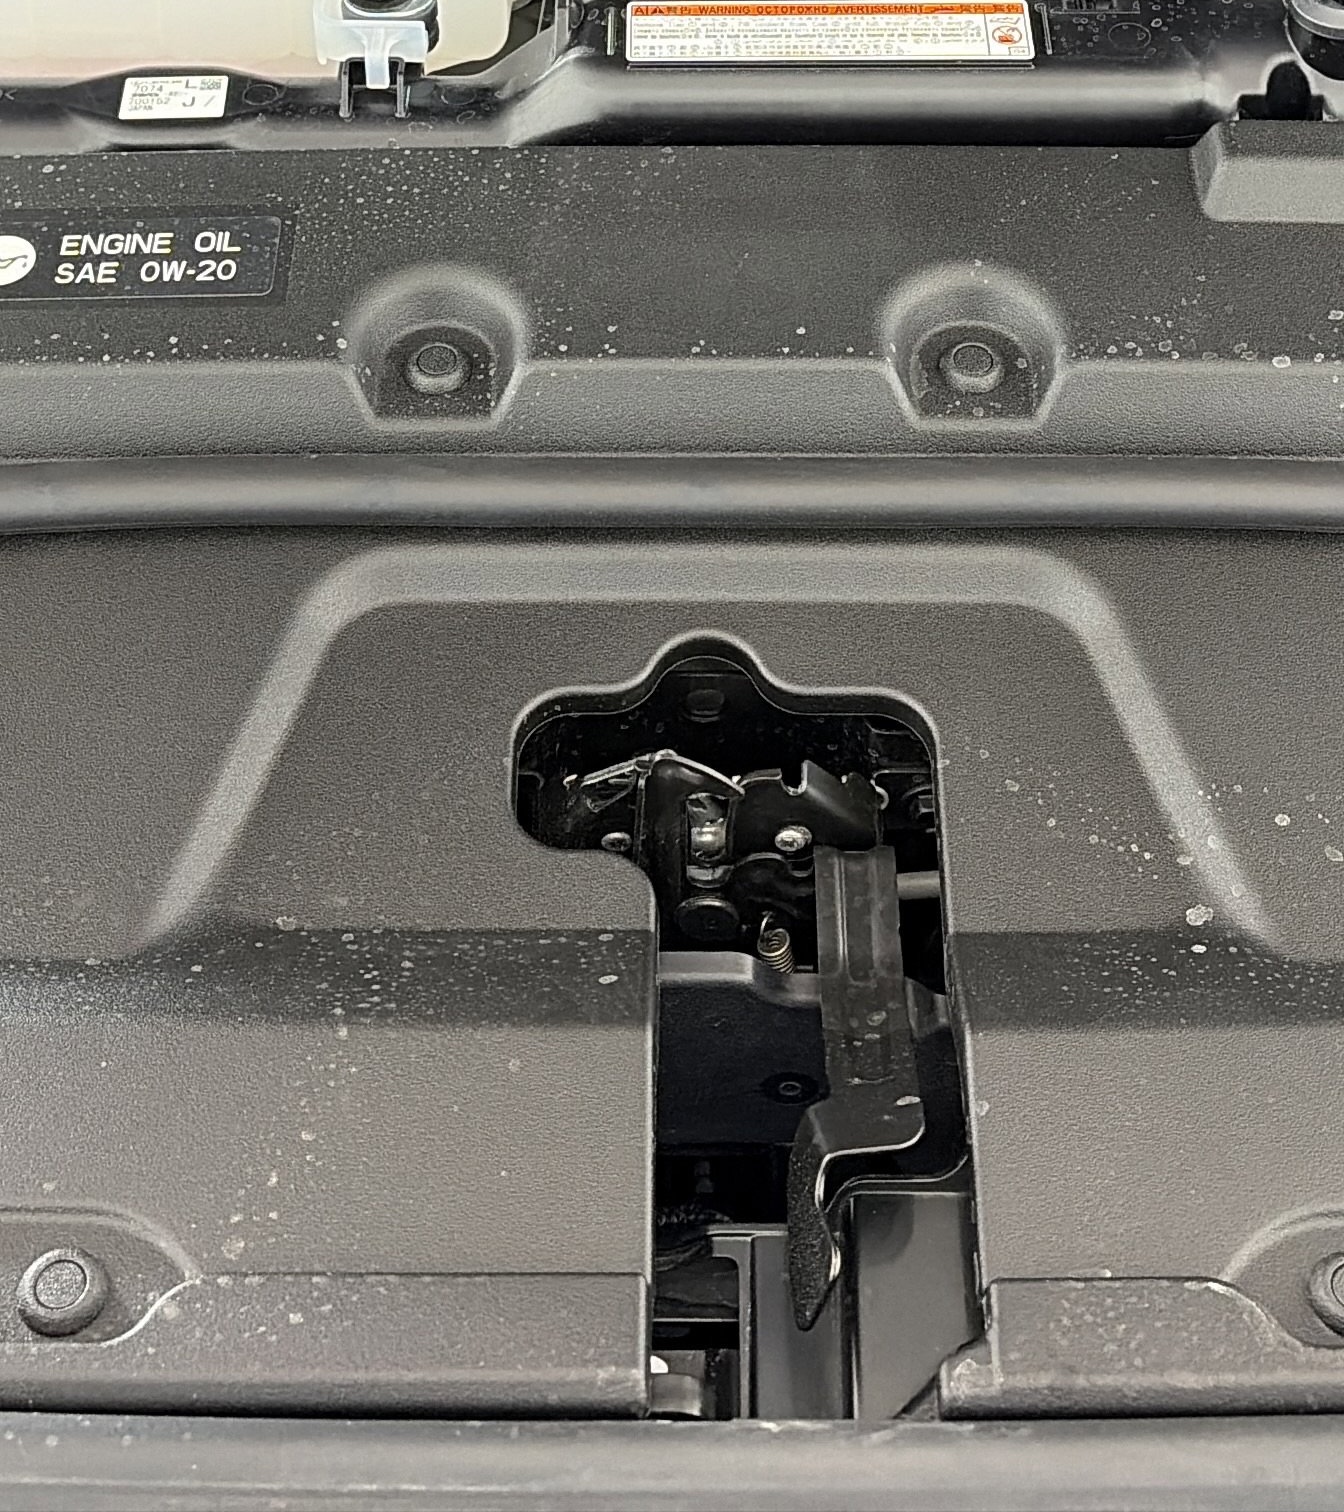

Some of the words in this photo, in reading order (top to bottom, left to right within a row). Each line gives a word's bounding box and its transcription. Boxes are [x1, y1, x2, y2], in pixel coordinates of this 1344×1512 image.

[698, 5, 751, 15] WARNING
[834, 4, 924, 14] AVERTISSEMENT
[59, 232, 175, 257] ENGINE
[193, 231, 242, 254] OIL
[54, 261, 121, 284] SAE
[139, 259, 238, 283] 0W-20
